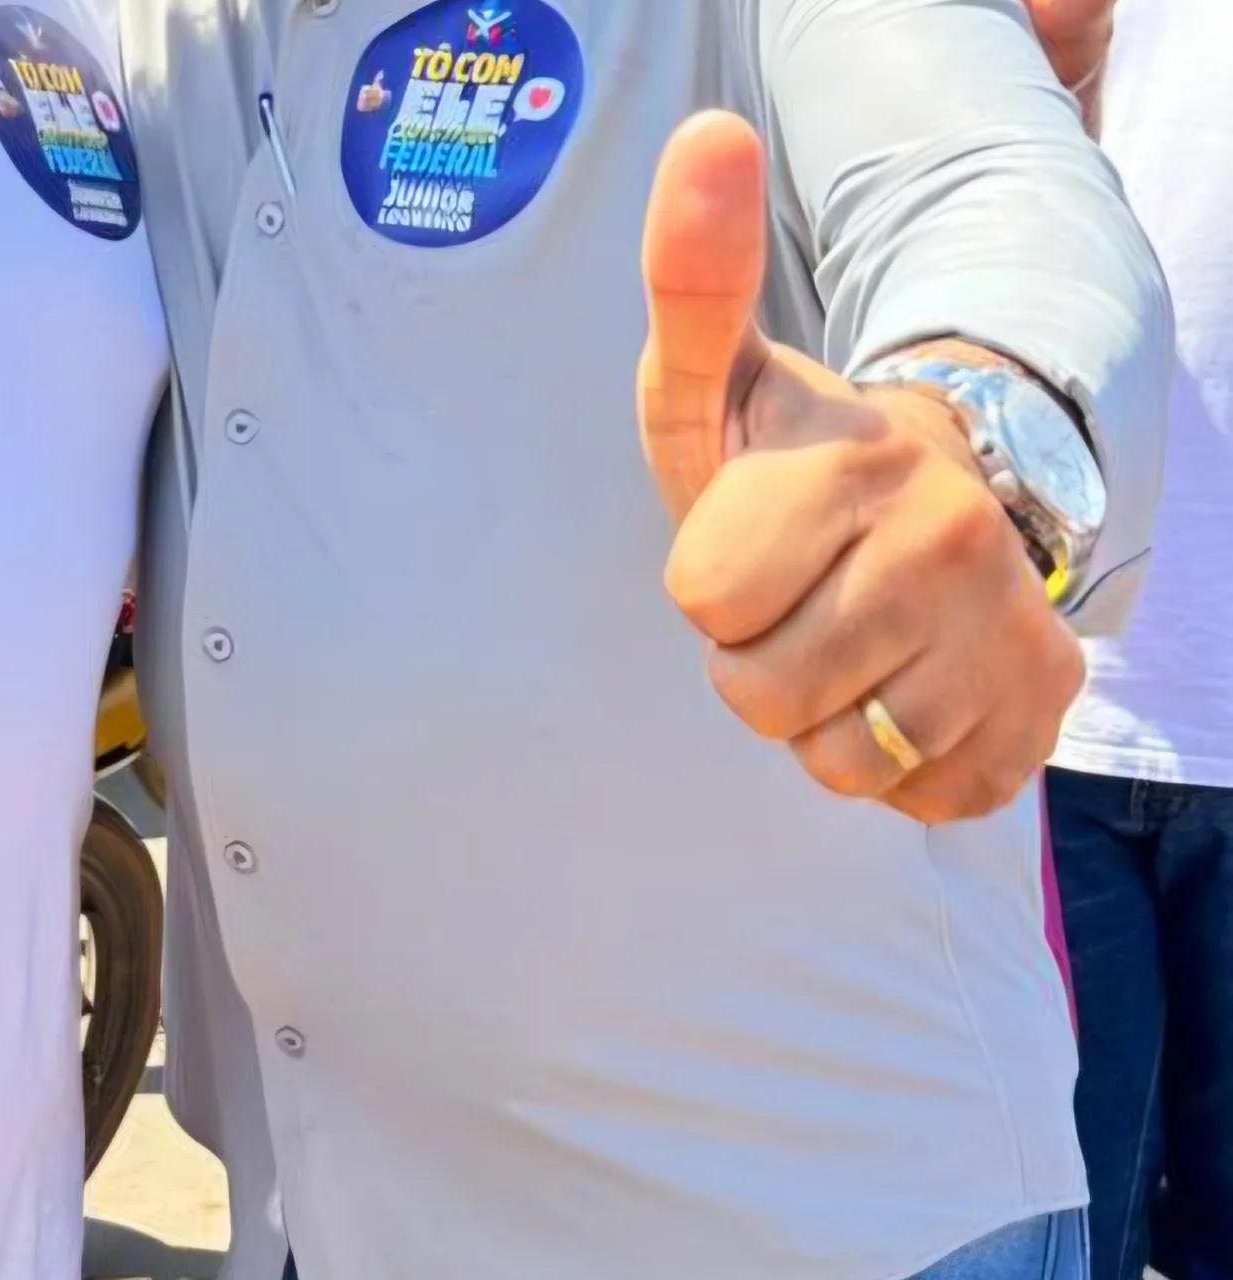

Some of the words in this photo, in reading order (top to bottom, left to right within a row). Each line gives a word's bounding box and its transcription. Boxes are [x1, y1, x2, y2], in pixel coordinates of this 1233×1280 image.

[411, 43, 453, 81] TÔ
[454, 52, 525, 84] COM
[398, 79, 516, 132] ELE
[379, 139, 498, 178] FEDERAL
